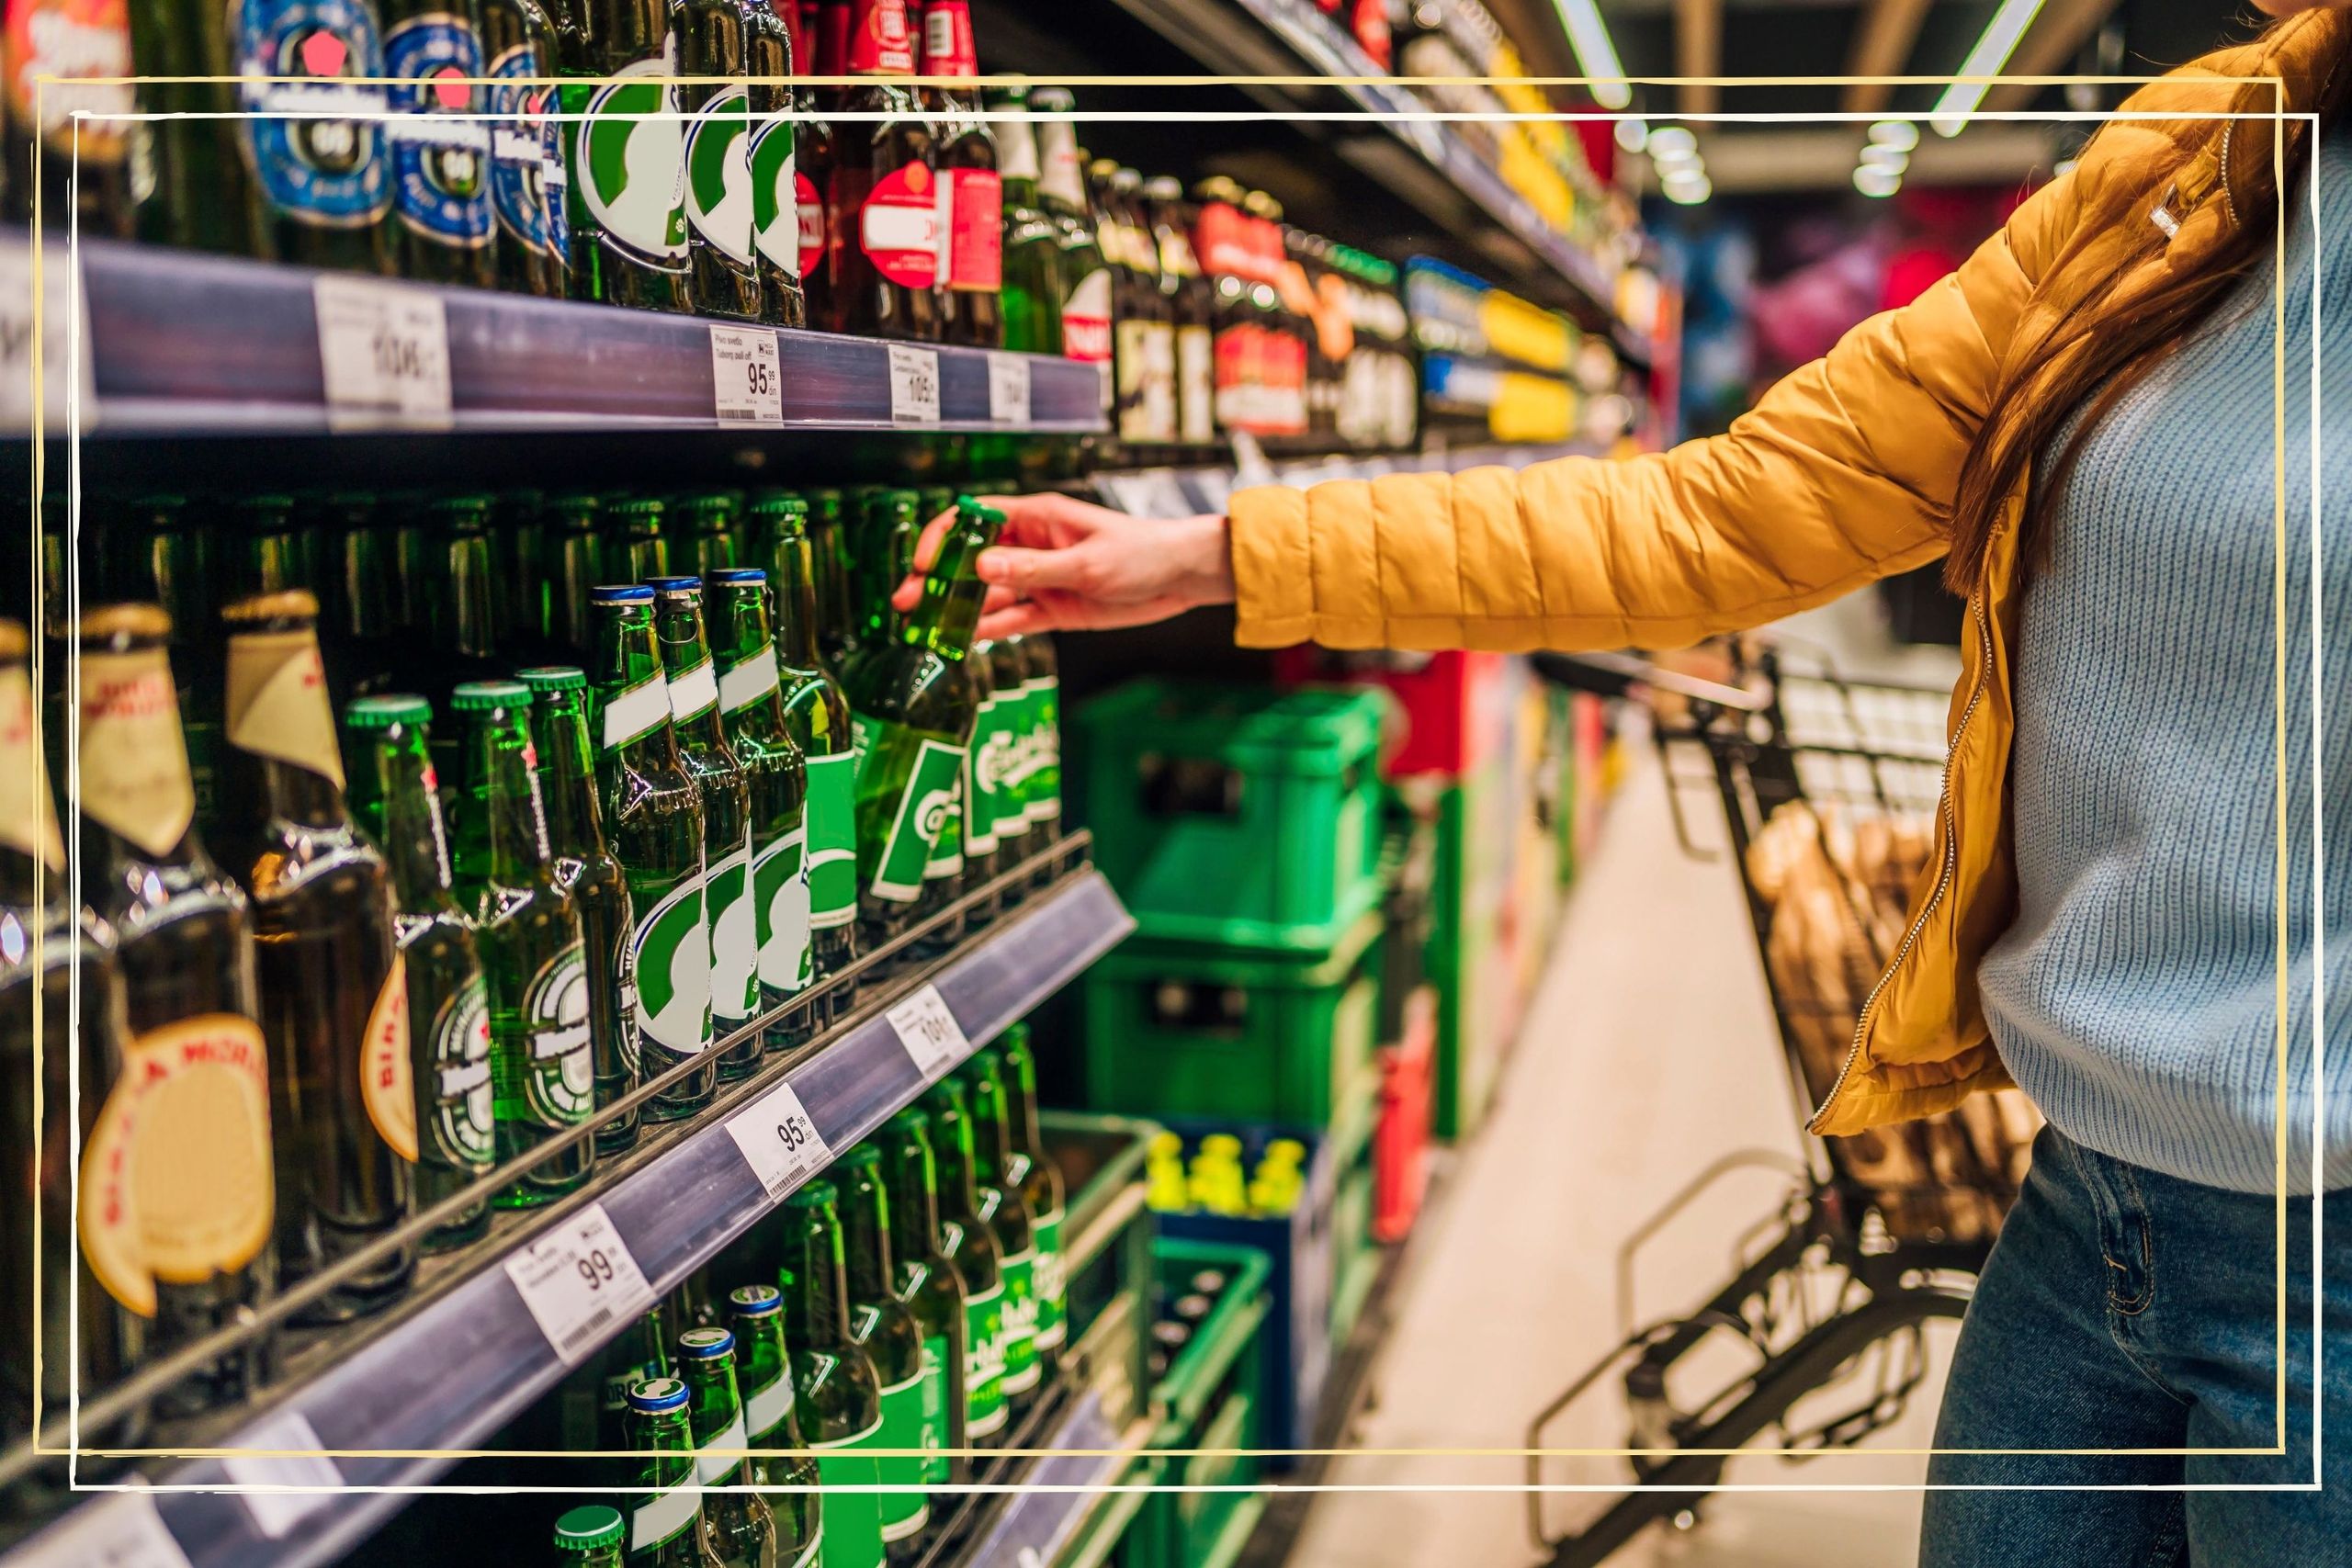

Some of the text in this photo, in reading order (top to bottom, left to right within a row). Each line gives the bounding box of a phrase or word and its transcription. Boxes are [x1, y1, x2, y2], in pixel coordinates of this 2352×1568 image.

[748, 362, 768, 395] 95
[768, 370, 775, 381] 99
[768, 386, 777, 396] din
[797, 1116, 807, 1128] 99
[777, 1116, 805, 1153] 95
[578, 1249, 614, 1291] 99
